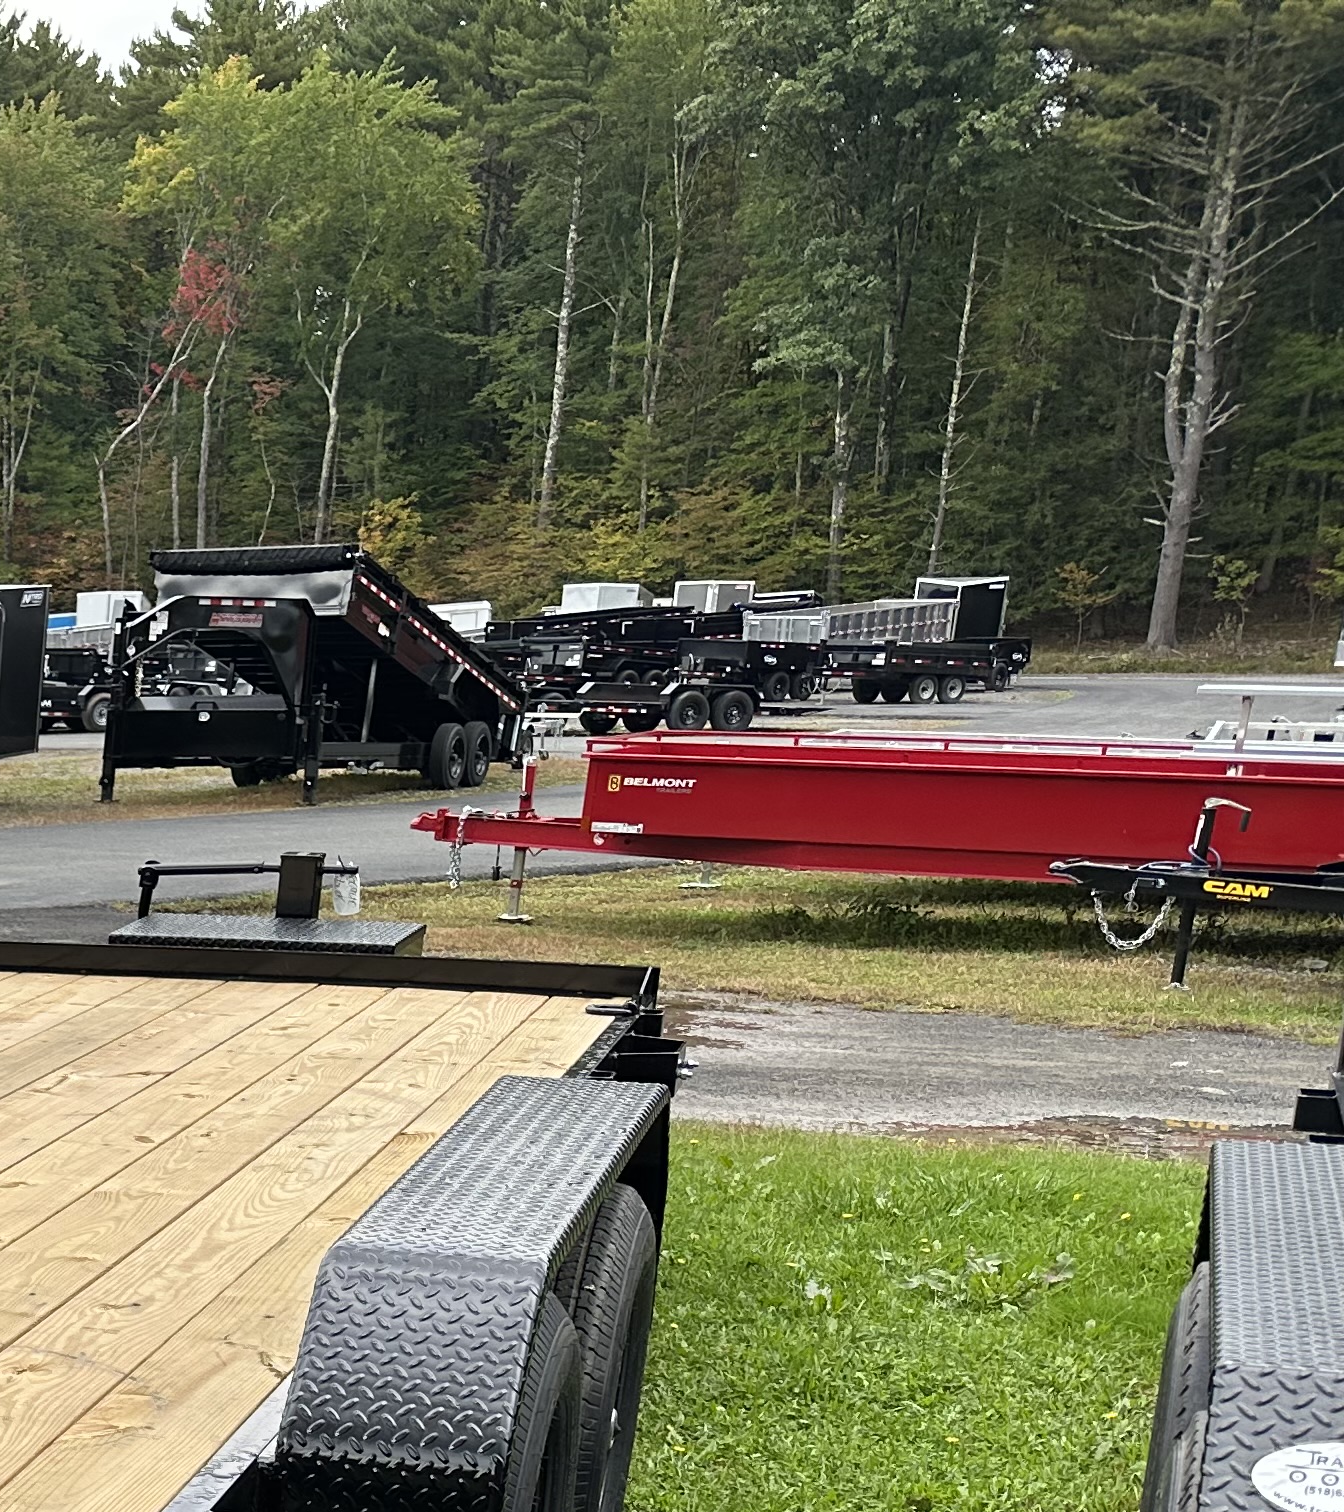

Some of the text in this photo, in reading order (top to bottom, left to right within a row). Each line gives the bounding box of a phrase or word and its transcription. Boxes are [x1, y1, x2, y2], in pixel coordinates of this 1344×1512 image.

[623, 777, 697, 788] BELMONT
[1203, 880, 1270, 898] CAM
[1305, 1486, 1344, 1498] (518)6
